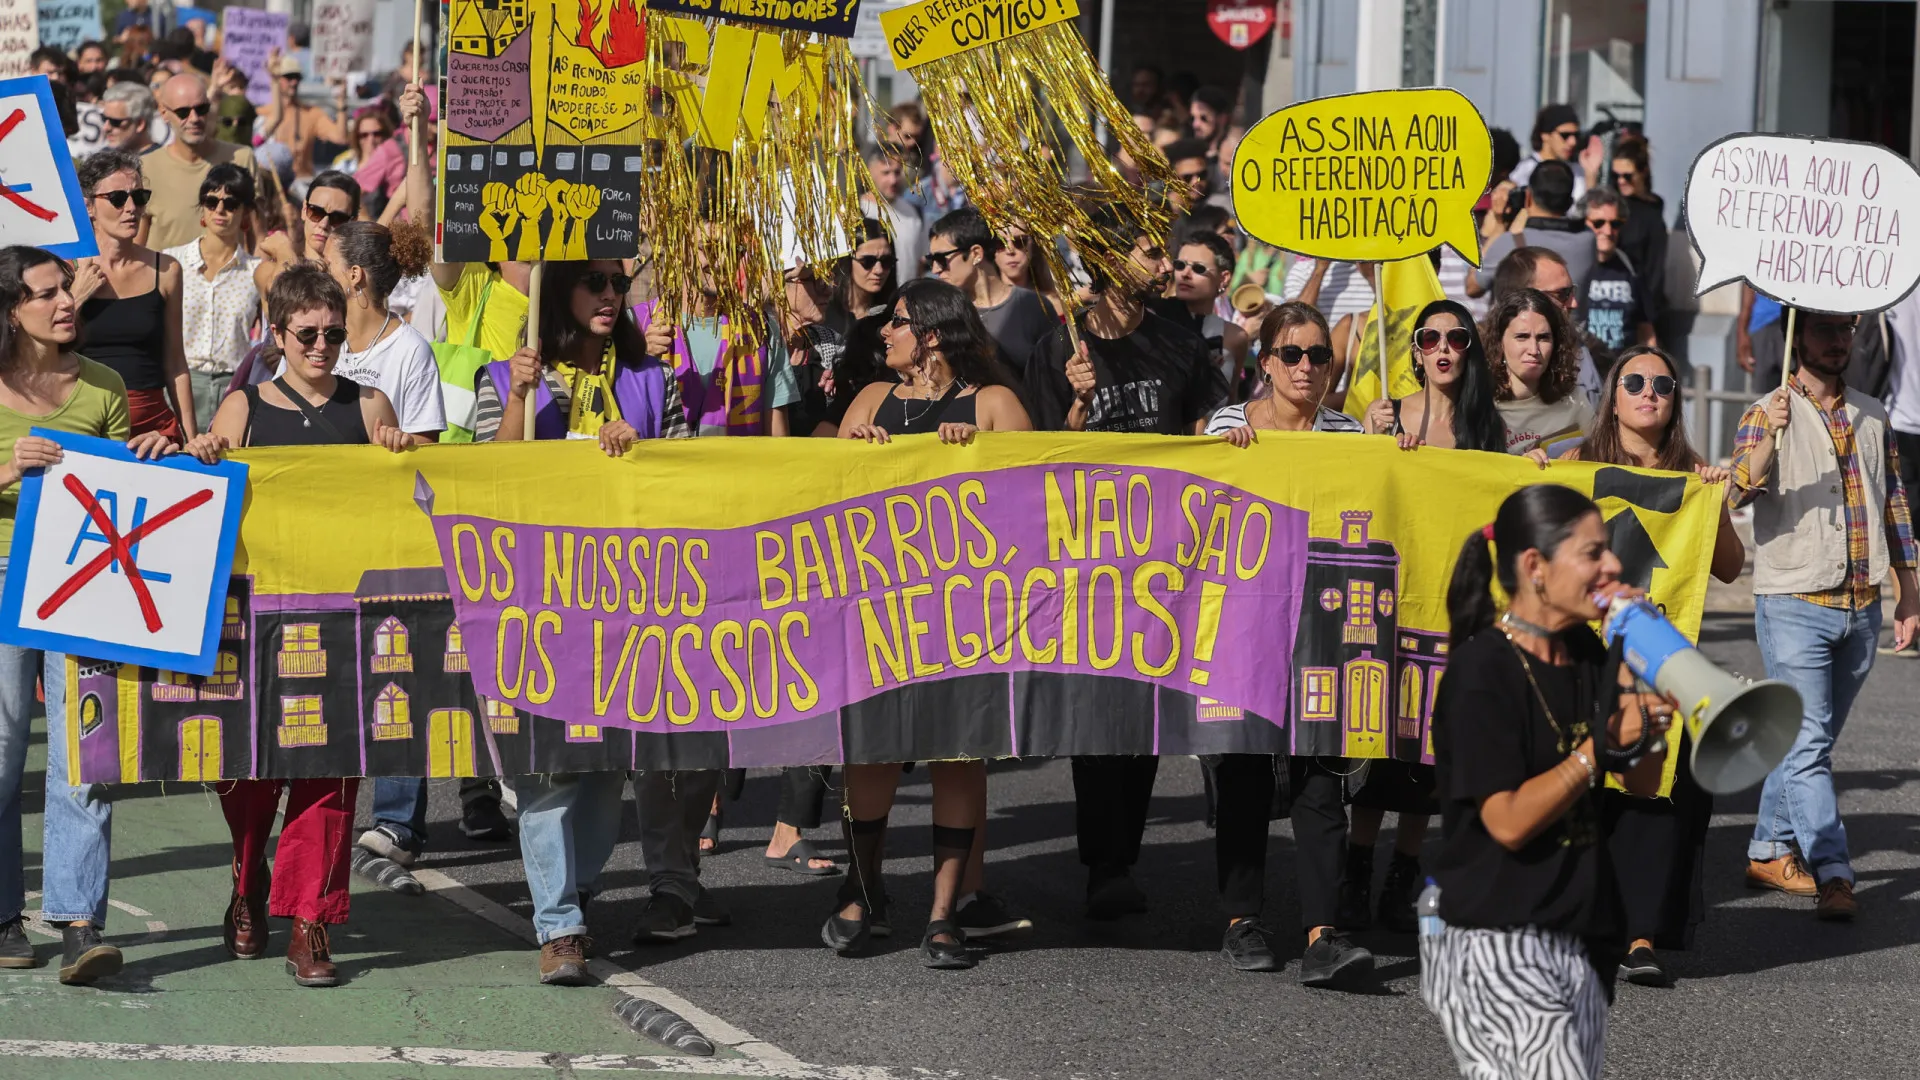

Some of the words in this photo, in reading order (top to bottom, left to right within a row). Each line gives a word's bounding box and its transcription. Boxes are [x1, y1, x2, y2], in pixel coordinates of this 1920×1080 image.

[893, 14, 929, 60] QUER
[450, 59, 500, 72] QUEREMOS
[502, 60, 529, 73] CASA
[553, 56, 569, 74] AS
[572, 64, 616, 85] RENDAS
[622, 69, 641, 85] SÃO
[451, 75, 457, 84] E
[461, 75, 511, 88] QUEREMOS
[450, 98, 470, 106] ESSE
[475, 99, 507, 108] PACOTE
[511, 99, 521, 108] DE
[622, 103, 638, 116] DA
[504, 109, 510, 117] A
[570, 116, 609, 133] CIDADE
[1280, 116, 1396, 154] ASSINA
[1405, 113, 1457, 152] AQUI
[1241, 158, 1261, 192] O
[1273, 155, 1406, 192] REFERENDO
[1413, 155, 1466, 191] PELA
[1711, 147, 1789, 189] ASSINA
[1803, 155, 1852, 197] AQUI
[1862, 163, 1880, 200] O
[450, 183, 479, 194] CASAS
[454, 201, 474, 212] PARA
[612, 209, 633, 222] PARA
[1300, 193, 1438, 245] HABITAÇÃO
[1717, 187, 1843, 238] REFERENDO
[1854, 204, 1900, 246] PELA
[446, 219, 479, 234] HABITAR
[596, 223, 633, 242] LUTAR
[1756, 239, 1894, 290] HABITAÇÃO!
[348, 368, 381, 379] BAIRROS
[66, 489, 172, 584] AL
[451, 523, 516, 602] OS
[542, 531, 710, 618] NOSSOS
[1044, 468, 1153, 562] NÃO
[1175, 483, 1273, 581] SÃO
[496, 605, 563, 705] OS
[593, 610, 820, 726] VOSSOS
